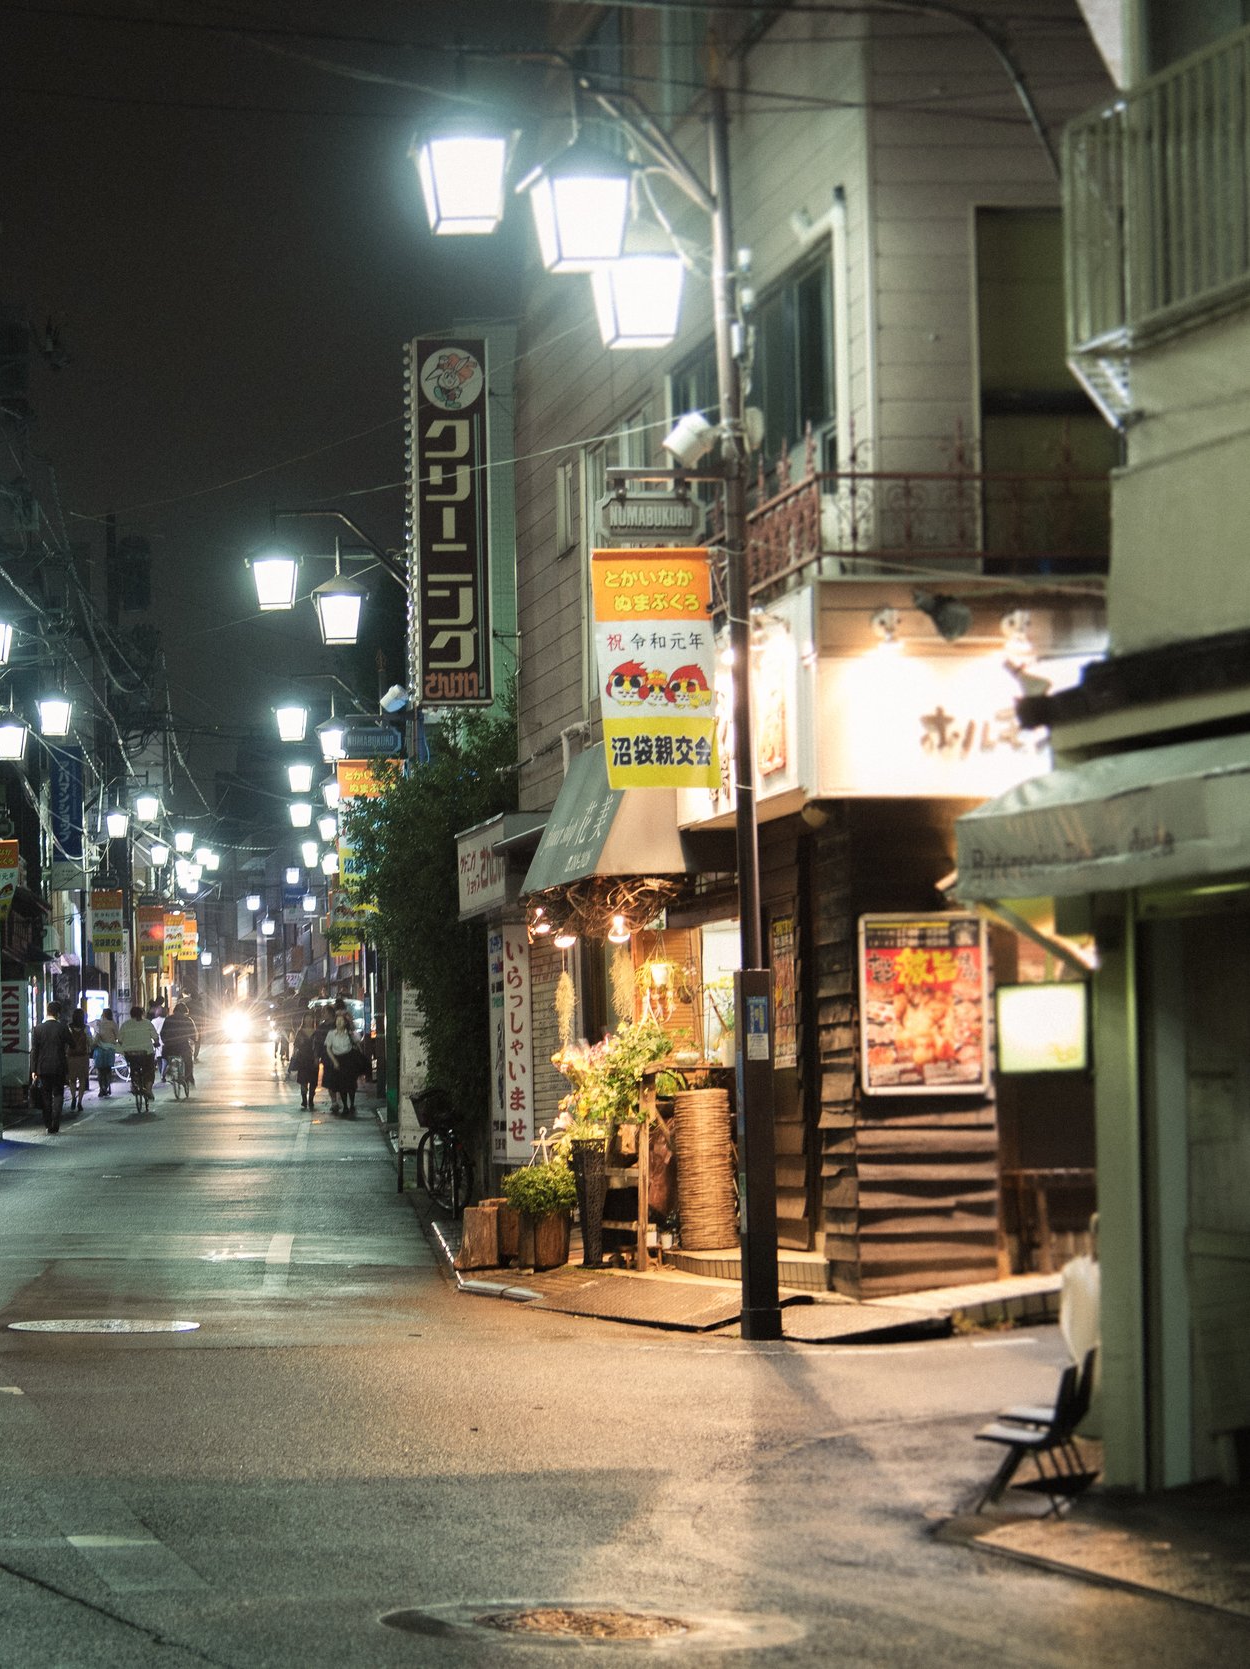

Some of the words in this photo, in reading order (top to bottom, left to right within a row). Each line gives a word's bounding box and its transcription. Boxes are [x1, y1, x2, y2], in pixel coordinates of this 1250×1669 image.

[610, 505, 692, 528] NUMABUKURO
[425, 420, 478, 669] クリーニング
[604, 568, 693, 588] とかいなか
[613, 593, 700, 612] ぬまぶくろ
[607, 633, 625, 652] 祝
[630, 632, 704, 650] 令和元年
[425, 671, 479, 698] さんけい
[611, 734, 711, 766] 沼袋親交会
[1, 985, 20, 1054] KIRIN
[505, 940, 527, 1142] いらっしゃいませ
